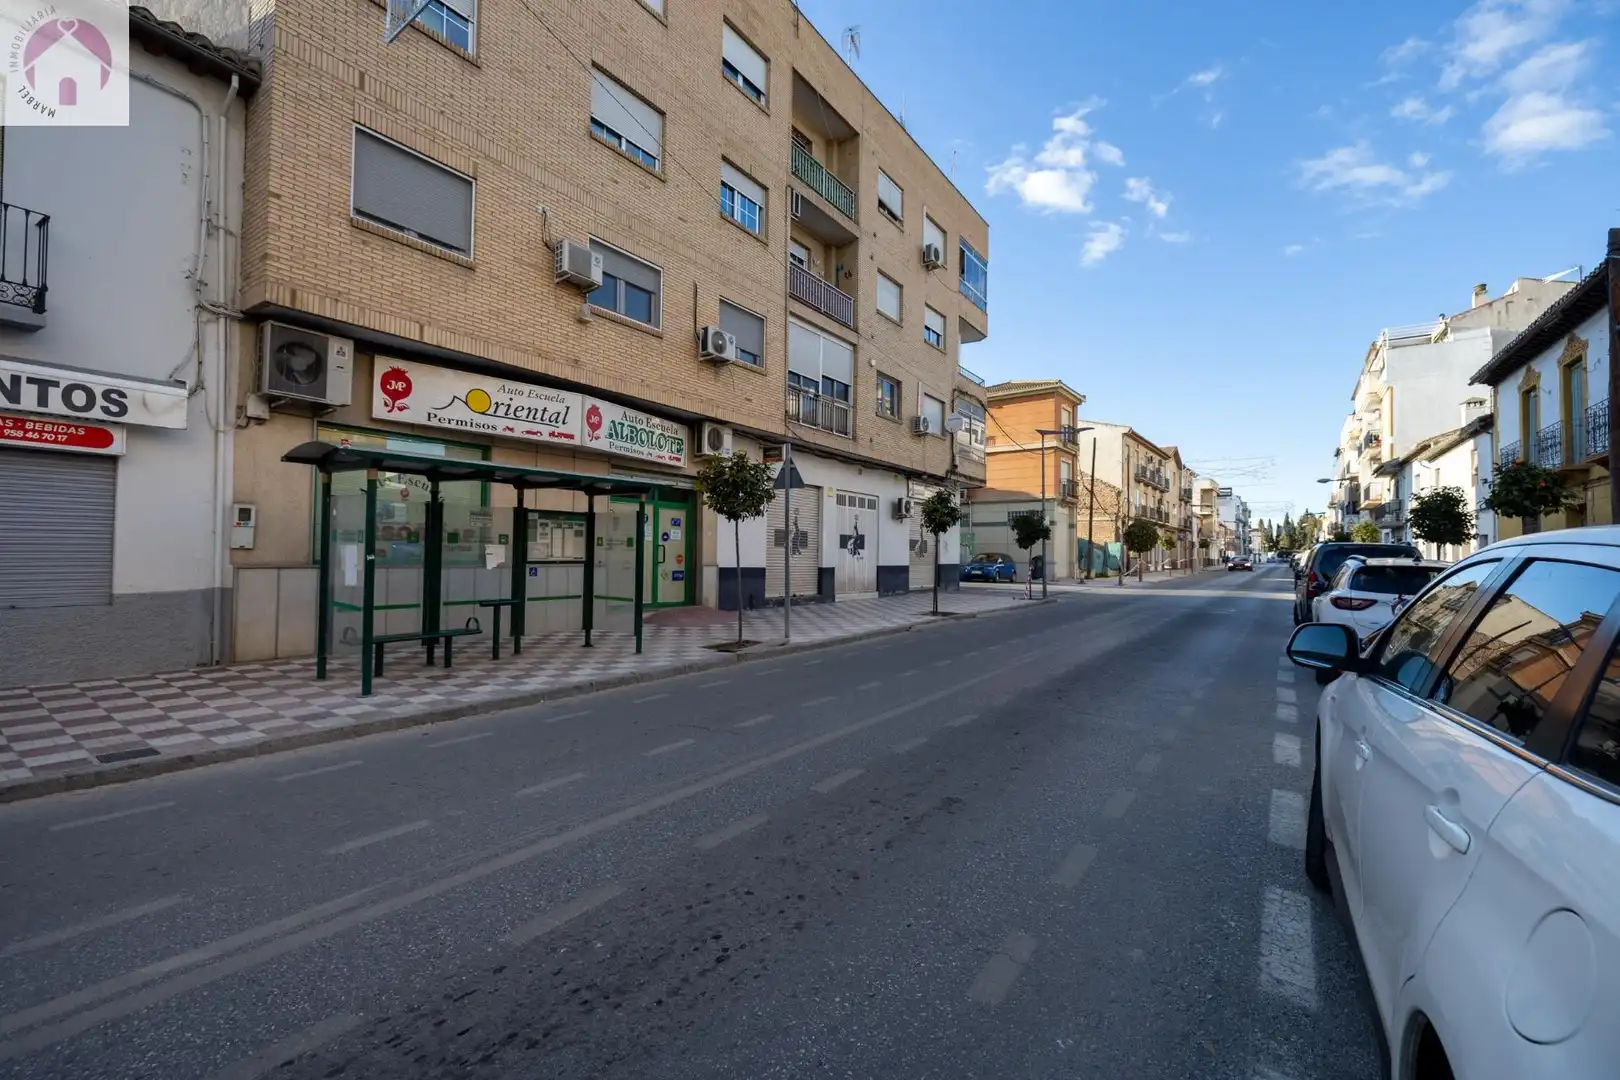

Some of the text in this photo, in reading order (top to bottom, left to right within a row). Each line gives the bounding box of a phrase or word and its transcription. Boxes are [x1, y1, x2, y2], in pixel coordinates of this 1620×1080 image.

[0, 374, 128, 417] NTOS
[497, 384, 566, 404] Auto Escuela
[25, 421, 86, 436] BEBIDAS
[427, 412, 498, 431] Permisos
[621, 411, 678, 435] Auto Escuela
[3, 428, 68, 443] 958 46 70 17
[605, 420, 684, 456] ALBOLOTE
[609, 441, 644, 456] Permisos
